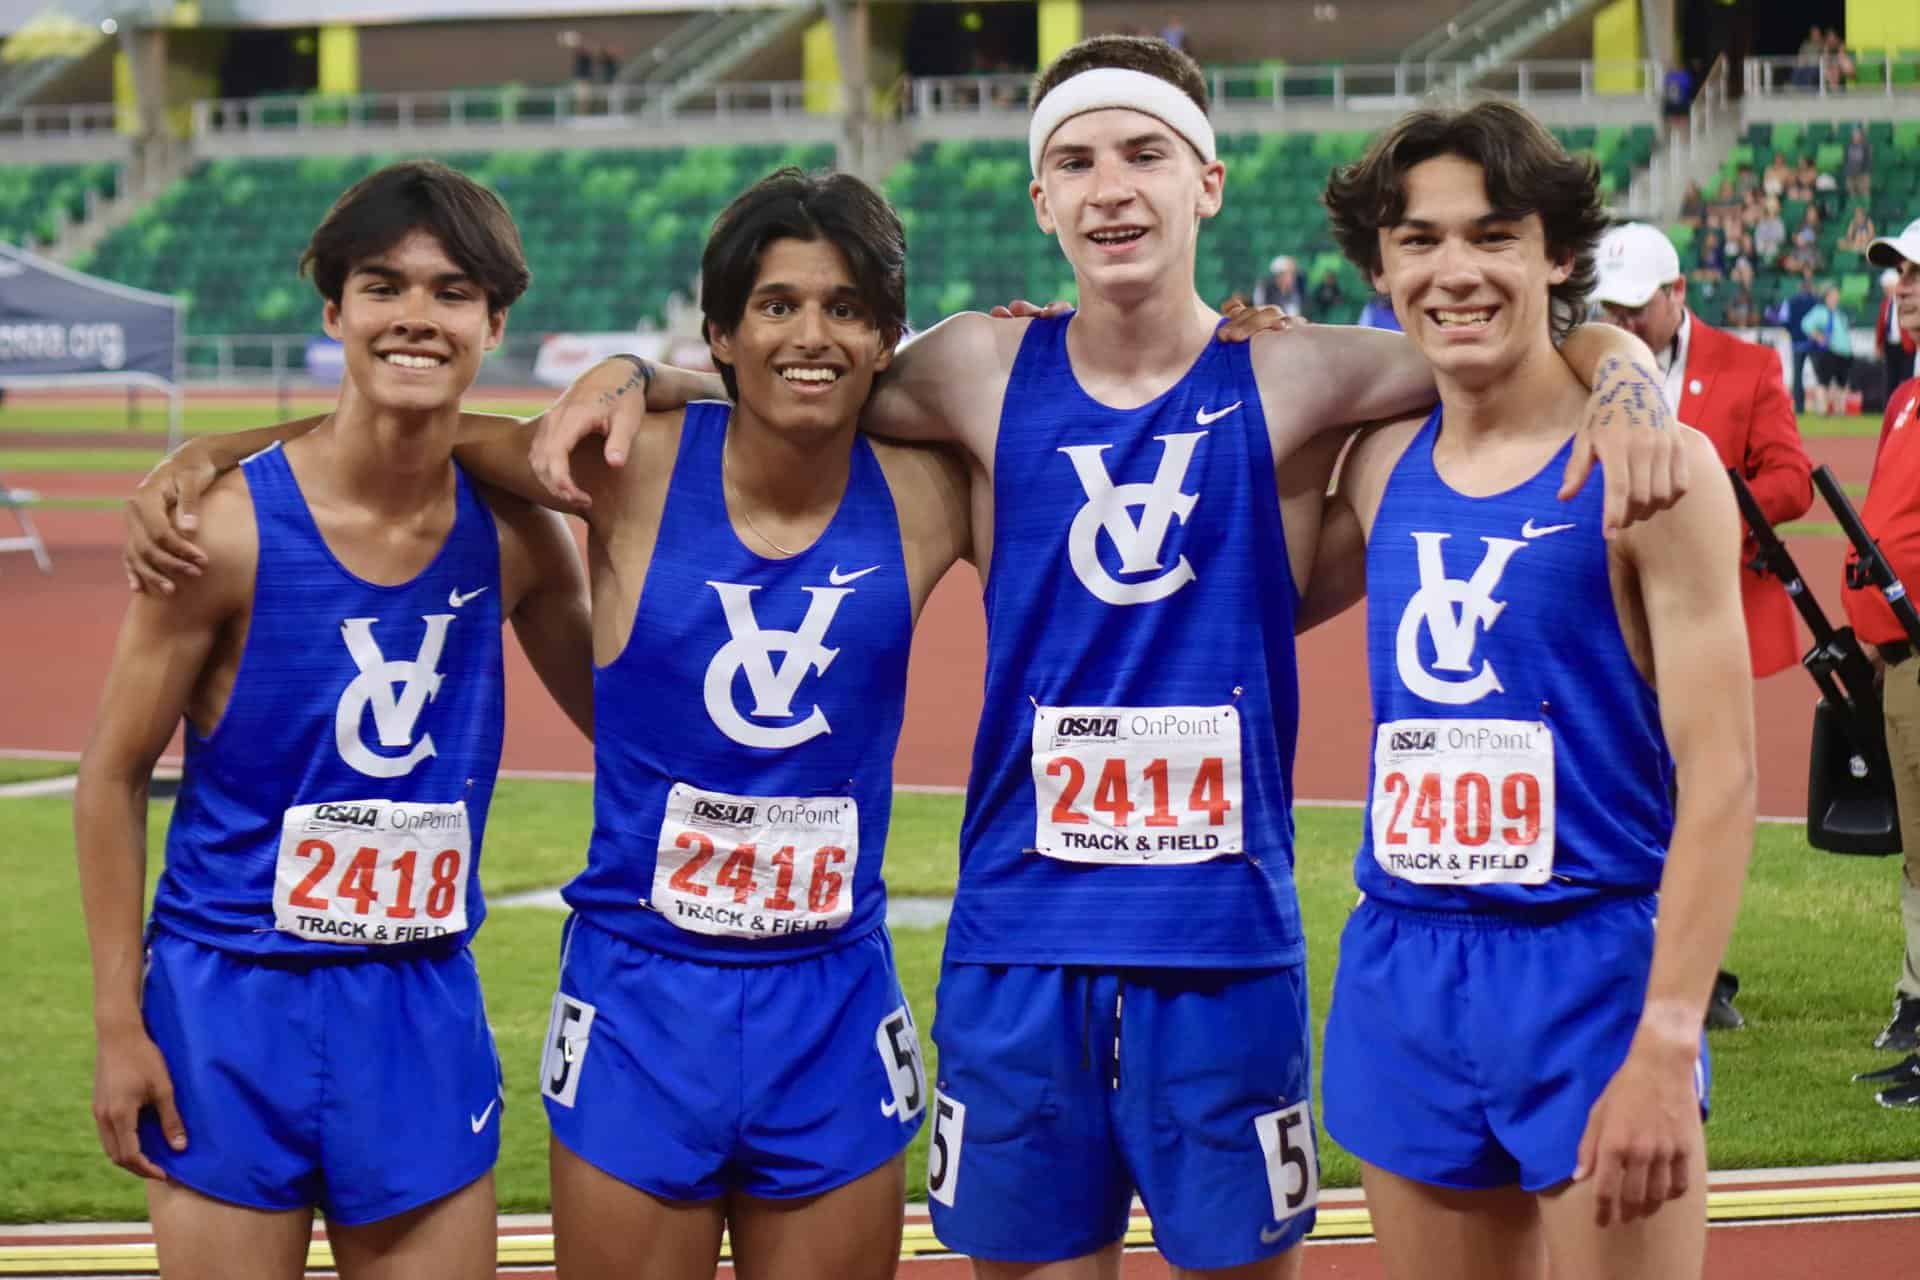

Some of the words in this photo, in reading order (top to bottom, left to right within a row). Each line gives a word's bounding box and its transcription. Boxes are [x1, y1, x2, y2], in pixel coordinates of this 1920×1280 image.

[1056, 717, 1119, 737] OSAA
[1131, 715, 1219, 736] OnPoint
[1391, 731, 1436, 750] OSAA
[1447, 728, 1532, 750] OnPoint
[315, 804, 378, 826] OSAA
[391, 809, 463, 830] OnPoint
[693, 800, 755, 824] OSAA
[767, 804, 840, 825] OnPoint
[1046, 756, 1231, 827] 2414
[1384, 772, 1541, 847] 2409
[1061, 832, 1129, 850] TRACK
[1136, 835, 1150, 850] &
[1158, 834, 1219, 850] FIELD
[1388, 853, 1442, 870] TRACK
[1447, 854, 1460, 870] &
[1469, 853, 1528, 870] FIELD
[288, 839, 461, 919] 2418
[669, 831, 846, 913] 2416
[296, 915, 368, 939] TRACK
[374, 925, 388, 940] &
[675, 900, 744, 927] TRACK
[750, 916, 765, 931] &
[550, 1002, 582, 1096] 5
[885, 1016, 920, 1111] 5
[929, 1099, 954, 1192] 5
[1277, 1111, 1309, 1209] 5
